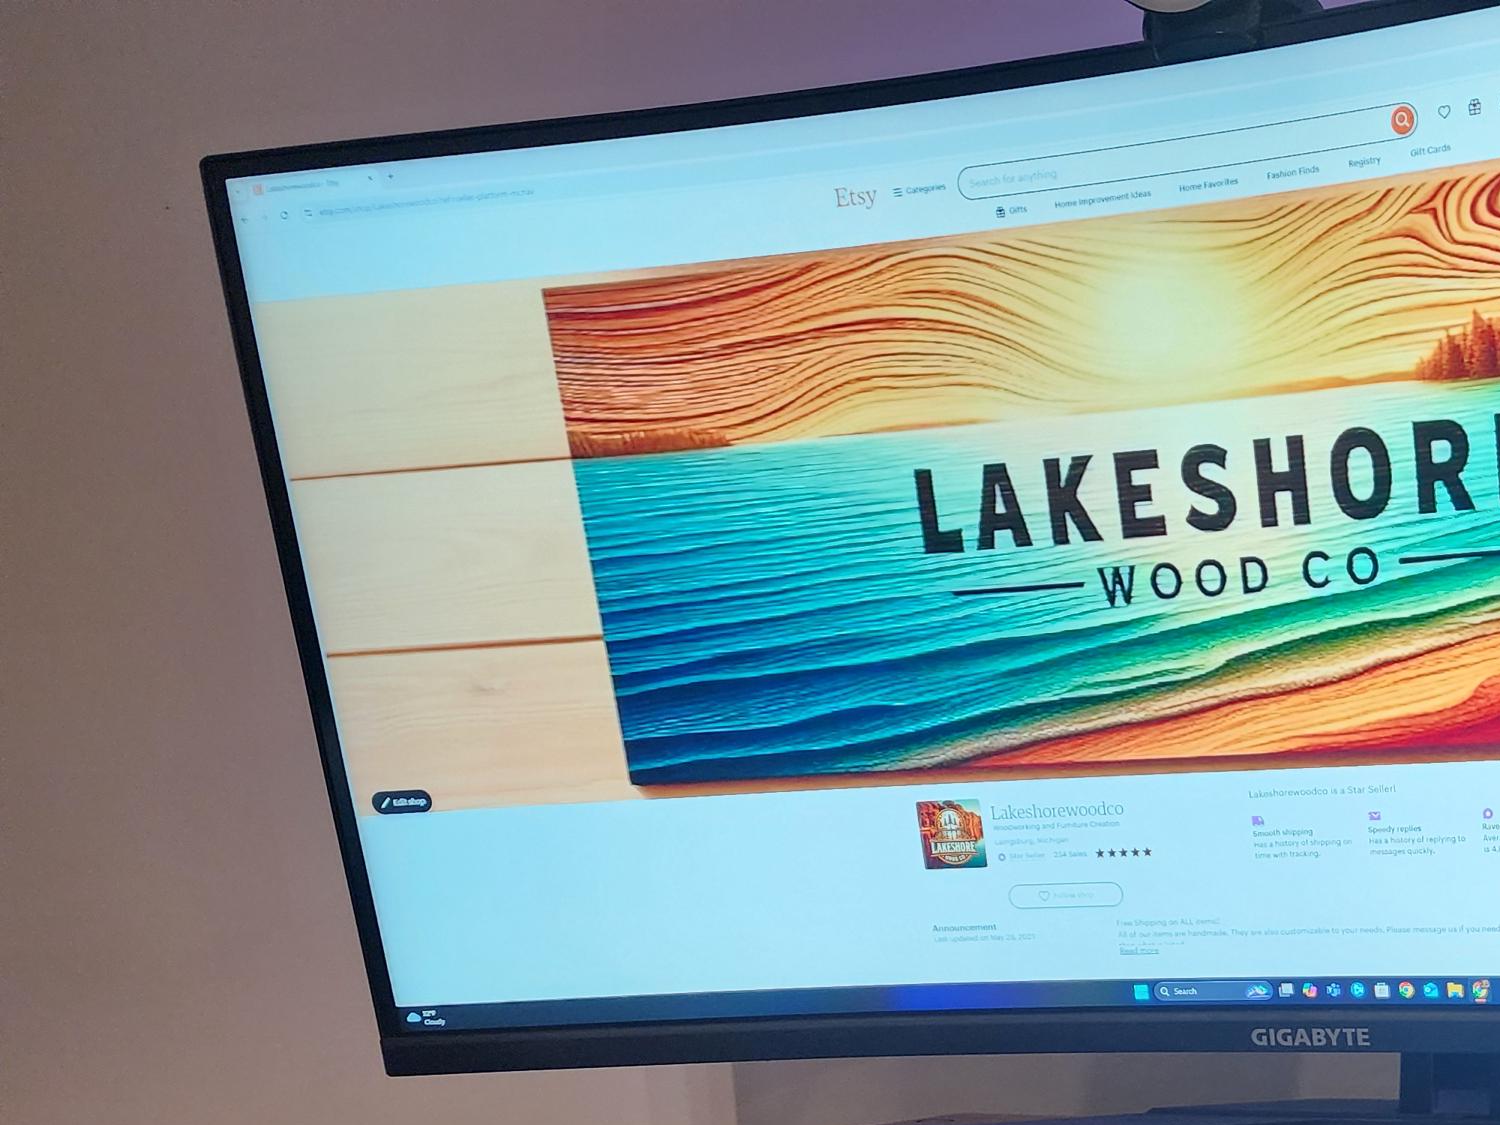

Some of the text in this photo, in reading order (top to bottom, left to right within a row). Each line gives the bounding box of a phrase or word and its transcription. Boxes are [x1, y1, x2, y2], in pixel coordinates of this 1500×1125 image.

[1411, 144, 1451, 158] Gift Cards
[1348, 156, 1381, 168] Registry
[1267, 165, 1320, 180] Fashion Finds
[969, 169, 1057, 189] Search for anything
[1179, 177, 1239, 192] Home Favorites
[906, 183, 946, 195] Categories
[834, 187, 877, 210] Etsy
[1054, 190, 1151, 208] Home Improvement Ideas
[1010, 206, 1027, 214] Gifts
[1098, 547, 1379, 607] WOOD CO
[1248, 787, 1328, 798] Lakeshorewoodco
[1347, 785, 1365, 795] Star
[990, 801, 1124, 820] Lakeshorewoodco
[1253, 827, 1313, 837] Smooth shipping
[1368, 825, 1421, 835] Speedy replies
[1275, 839, 1298, 848] history
[1310, 838, 1340, 848] shipping
[1391, 836, 1415, 844] history
[1427, 835, 1455, 844] replying
[931, 842, 977, 854] LAKESHORE
[1370, 848, 1405, 856] messages
[932, 924, 996, 932] Announcement
[1135, 919, 1166, 927] Shipping
[1120, 947, 1138, 955] Read
[1174, 987, 1197, 995] Search
[1251, 1028, 1369, 1046] GIGABYTE
